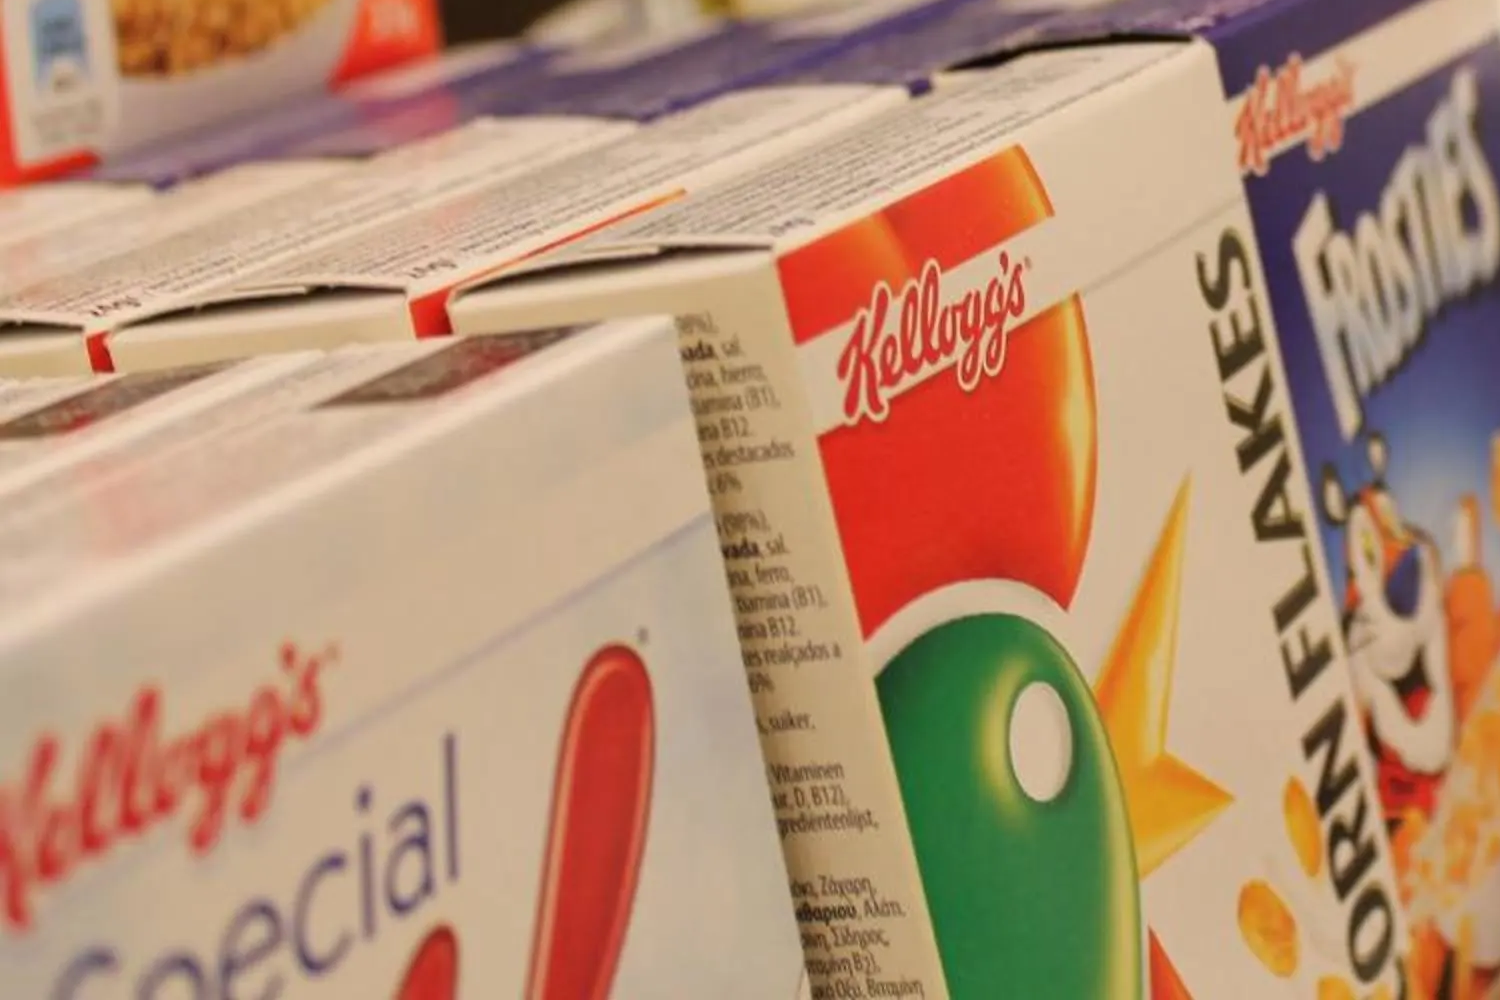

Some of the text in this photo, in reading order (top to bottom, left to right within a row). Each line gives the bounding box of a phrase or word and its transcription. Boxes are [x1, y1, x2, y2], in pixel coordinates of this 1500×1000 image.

[1234, 52, 1356, 177] Kellogg's
[838, 250, 1027, 420] Kellogg's
[1195, 223, 1410, 1000] ORN FLAKES
